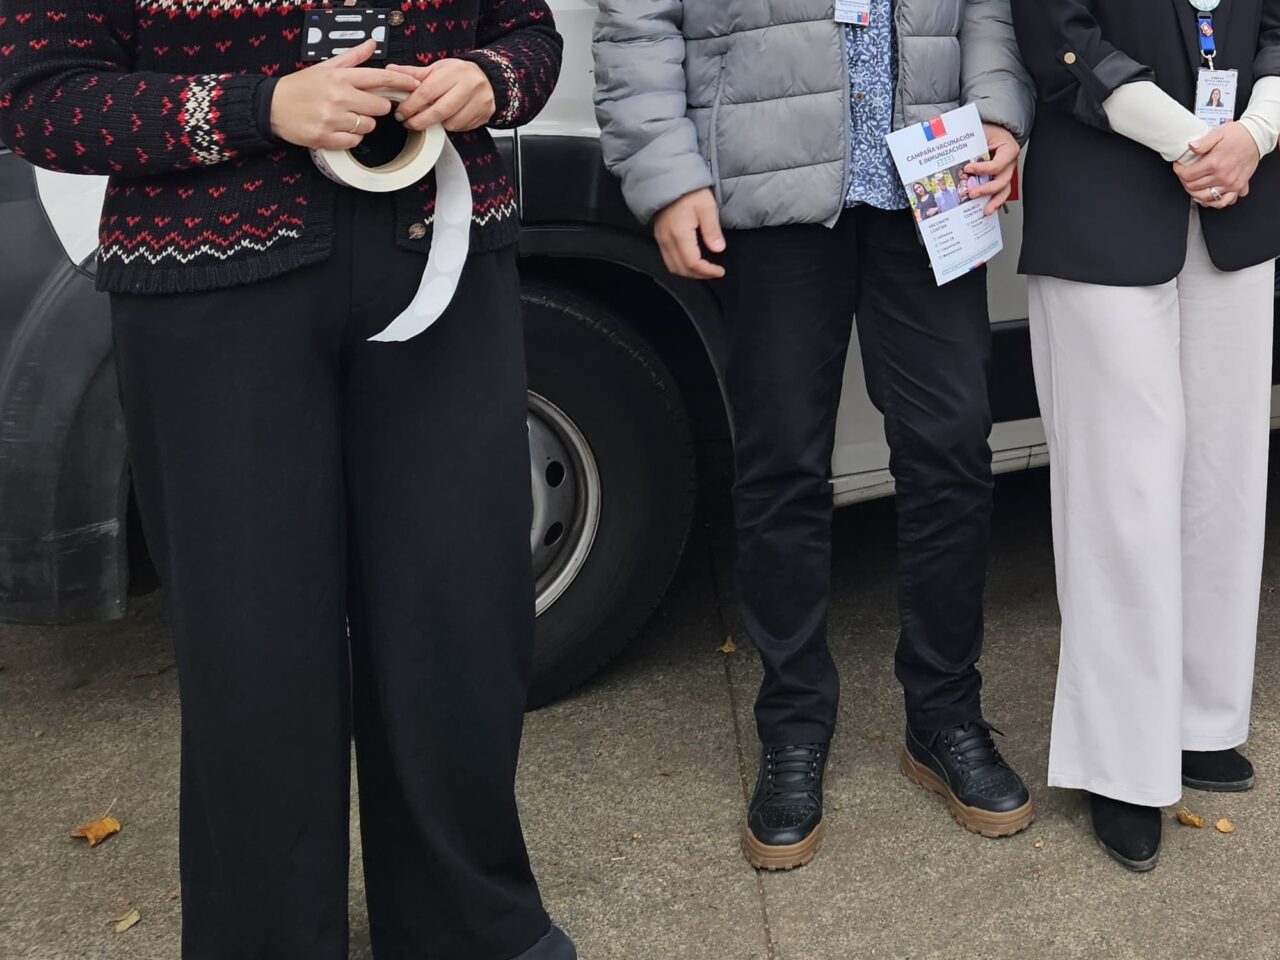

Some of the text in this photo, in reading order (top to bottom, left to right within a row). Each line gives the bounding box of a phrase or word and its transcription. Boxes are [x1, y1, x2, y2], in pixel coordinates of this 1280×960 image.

[906, 132, 975, 162] CAMPAÑA VACUNACIÓN
[923, 142, 968, 163] INMUNIZACIÓN
